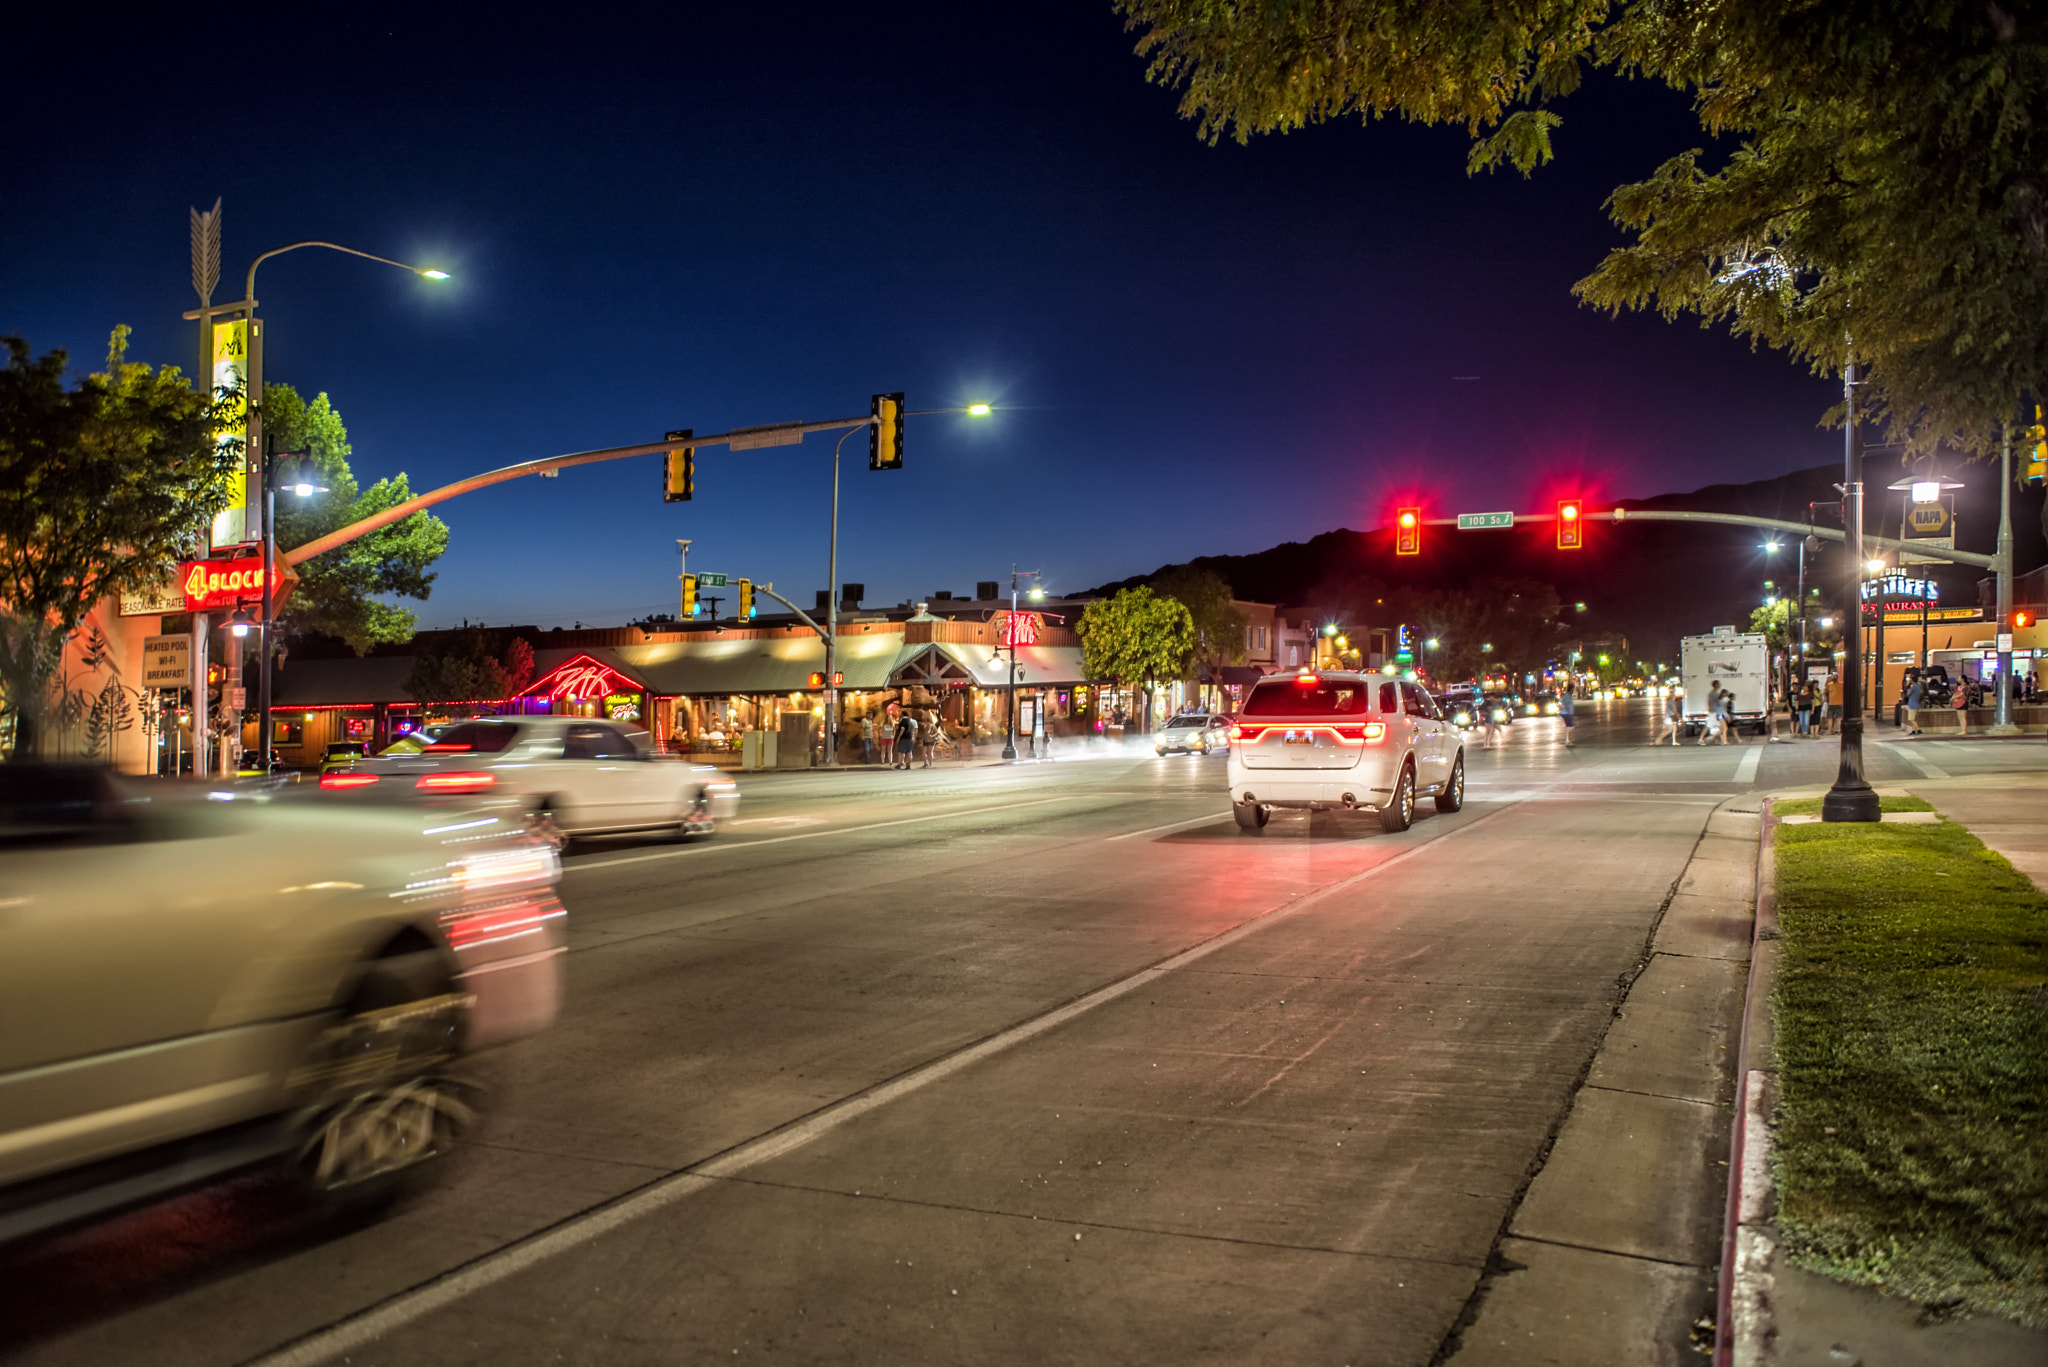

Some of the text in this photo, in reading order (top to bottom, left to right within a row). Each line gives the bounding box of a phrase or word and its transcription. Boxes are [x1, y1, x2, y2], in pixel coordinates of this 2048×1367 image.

[1469, 516, 1485, 526] 100
[1915, 511, 1941, 524] NAPA
[185, 565, 208, 600] 4
[701, 575, 714, 584] MAIN
[166, 596, 186, 609] RATES
[1861, 601, 1937, 613] ESAURANT
[145, 641, 188, 652] HEATED POOL
[159, 656, 176, 666] WI-FI
[147, 669, 185, 680] BREAKFAST
